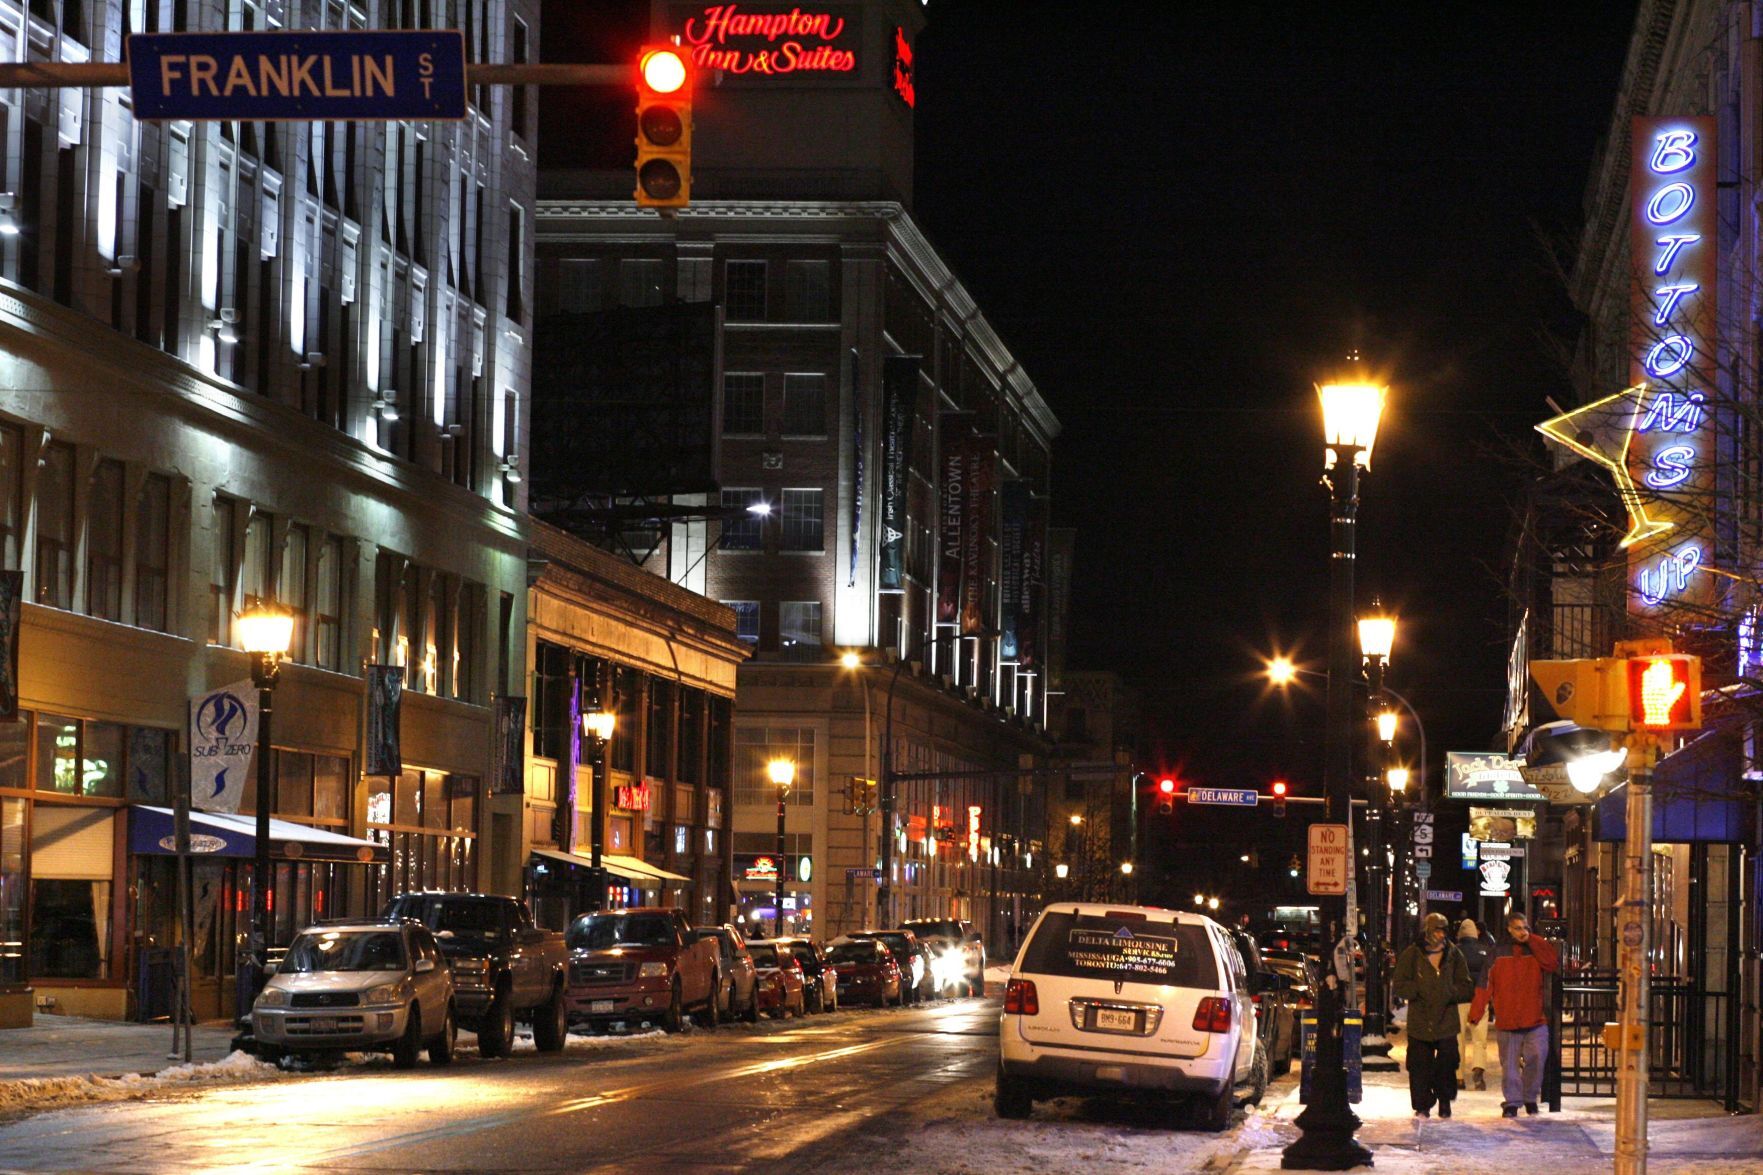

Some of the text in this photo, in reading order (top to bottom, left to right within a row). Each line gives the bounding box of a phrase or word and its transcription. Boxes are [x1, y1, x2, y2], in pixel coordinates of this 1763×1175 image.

[686, 5, 844, 44] Hampton
[691, 41, 855, 74] Inn & Suites
[160, 54, 395, 98] FRANKLIN
[1639, 129, 1703, 487] BOTTOMS
[886, 501, 894, 520] Irish
[945, 456, 962, 560] ALLENTOWN
[1641, 546, 1701, 606] UP
[193, 744, 251, 758] SUB ZERO
[1201, 791, 1244, 802] DELAWARE
[1320, 831, 1335, 844] NO
[1420, 828, 1427, 840] 5
[1311, 846, 1345, 856] STANDING
[1319, 857, 1335, 867] ANY
[1318, 868, 1336, 878] TIME
[1079, 936, 1168, 952] DELTA LIMOUSINE
